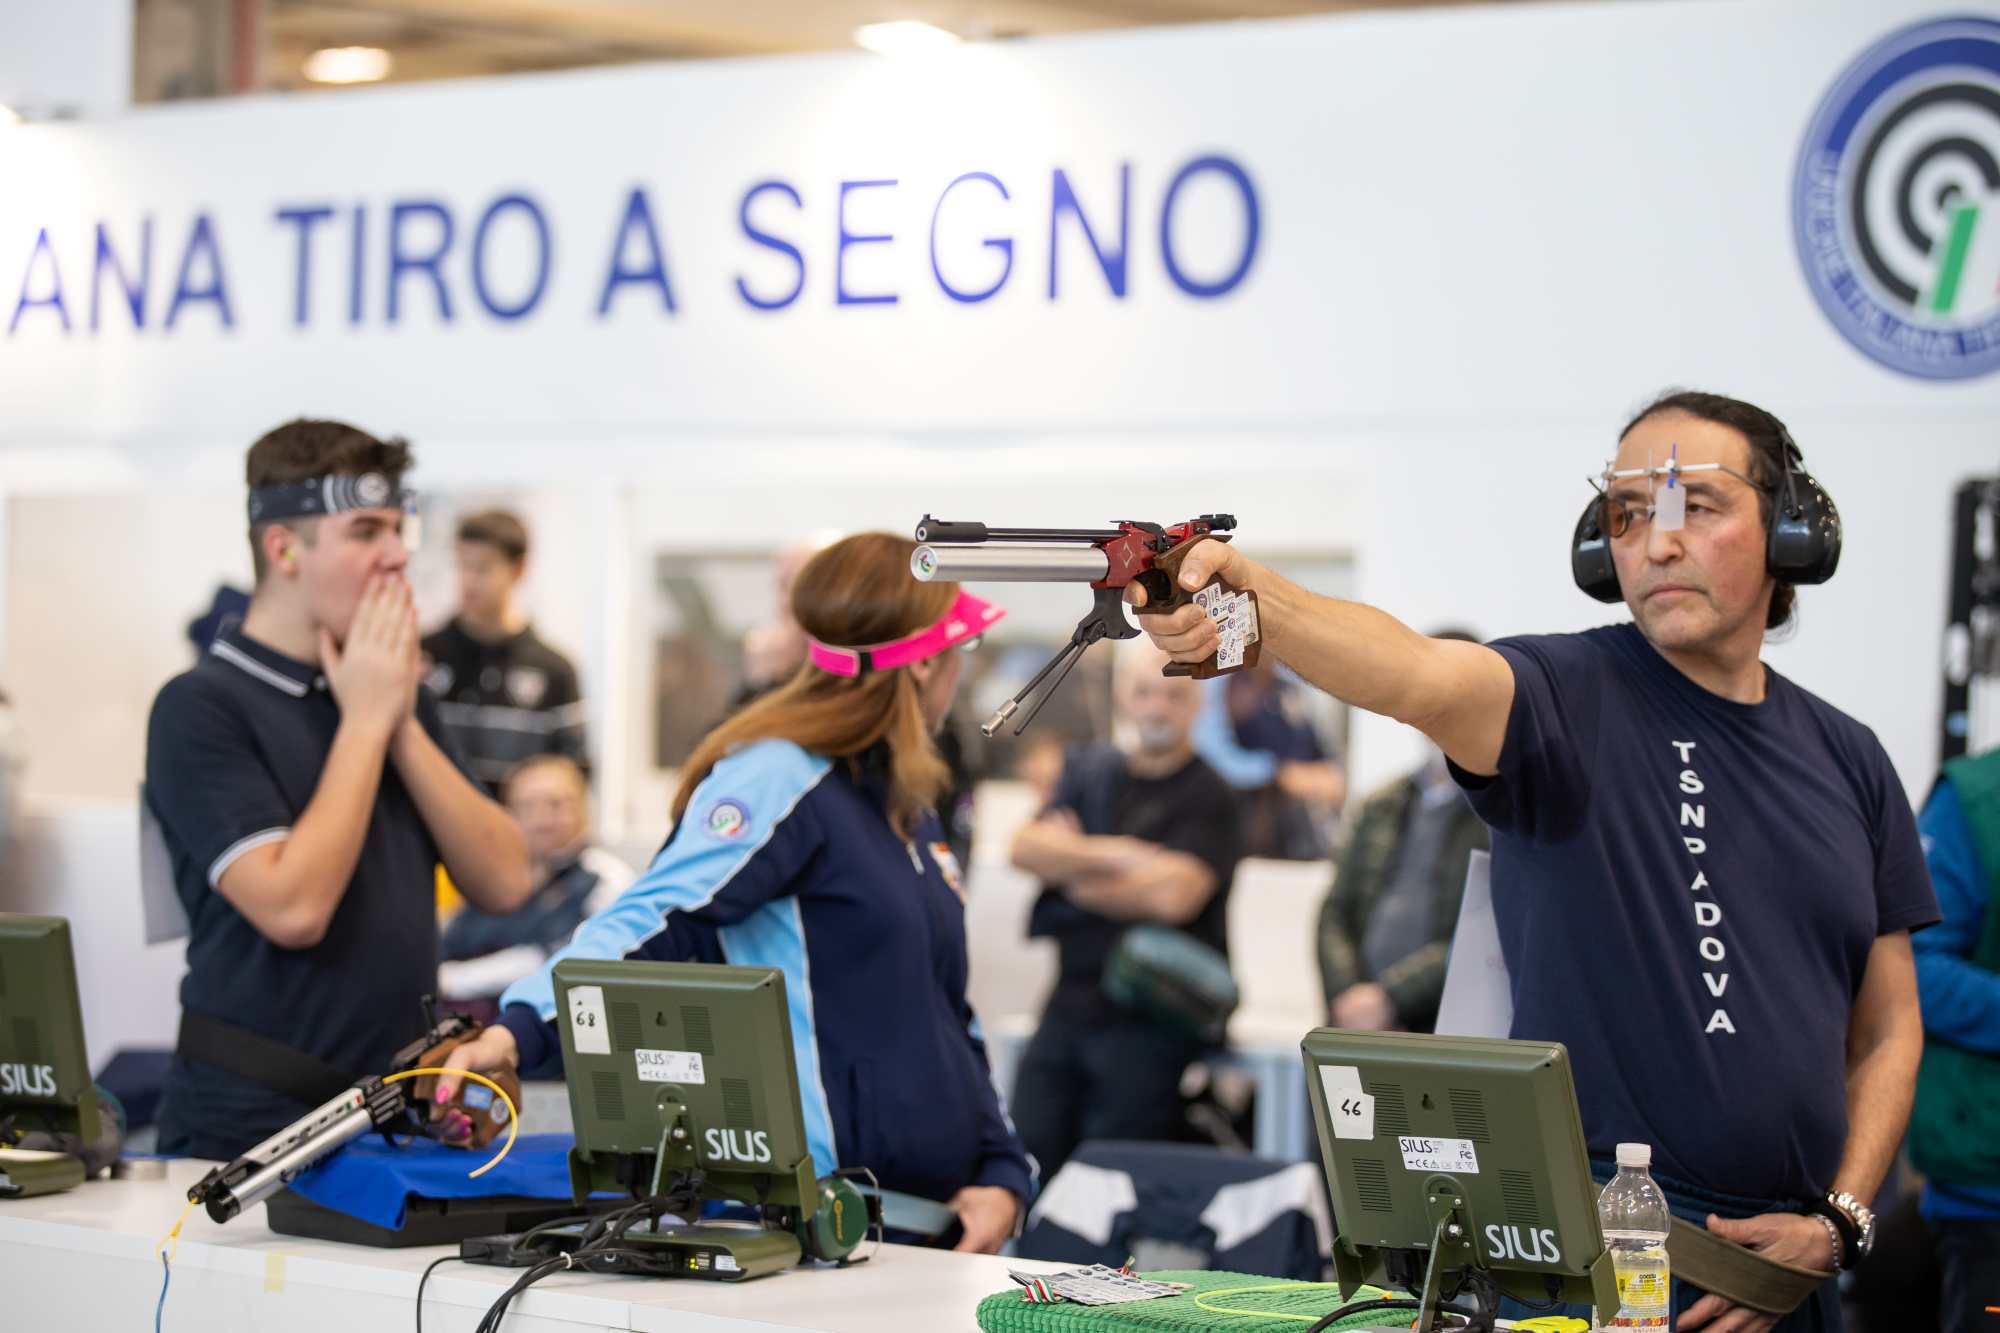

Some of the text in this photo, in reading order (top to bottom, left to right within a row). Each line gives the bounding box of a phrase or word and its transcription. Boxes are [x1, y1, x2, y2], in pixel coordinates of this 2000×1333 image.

[273, 193, 553, 323] TIRO
[596, 185, 680, 318] A
[734, 153, 1263, 312] SEGNO
[576, 1011, 595, 1027] 68
[637, 1052, 665, 1065] SIUS
[0, 1063, 57, 1096] SIUS
[1341, 1098, 1361, 1116] 46
[705, 1128, 772, 1163] SIUS
[1401, 1139, 1433, 1153] SIUS
[1485, 1224, 1561, 1263] SIUS
